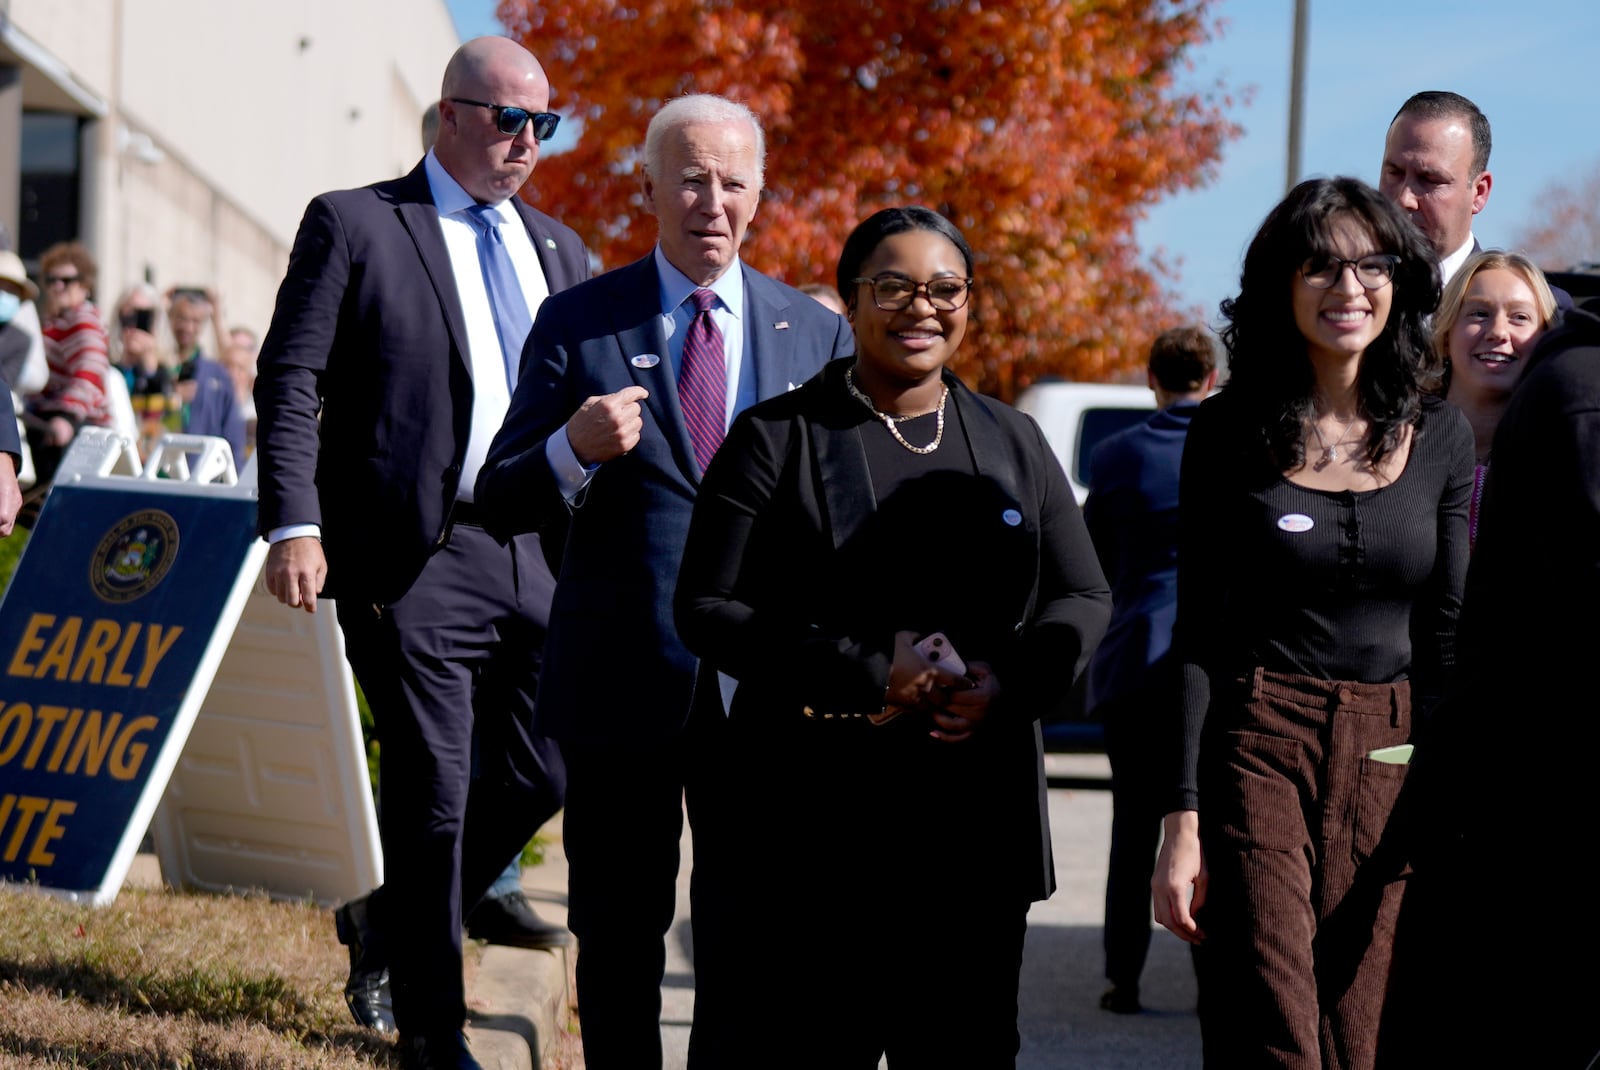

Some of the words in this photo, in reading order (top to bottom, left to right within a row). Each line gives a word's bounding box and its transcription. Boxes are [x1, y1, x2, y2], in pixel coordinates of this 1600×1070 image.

[7, 612, 184, 688] EARLY
[0, 701, 160, 781] OTING
[0, 794, 78, 867] ITE
